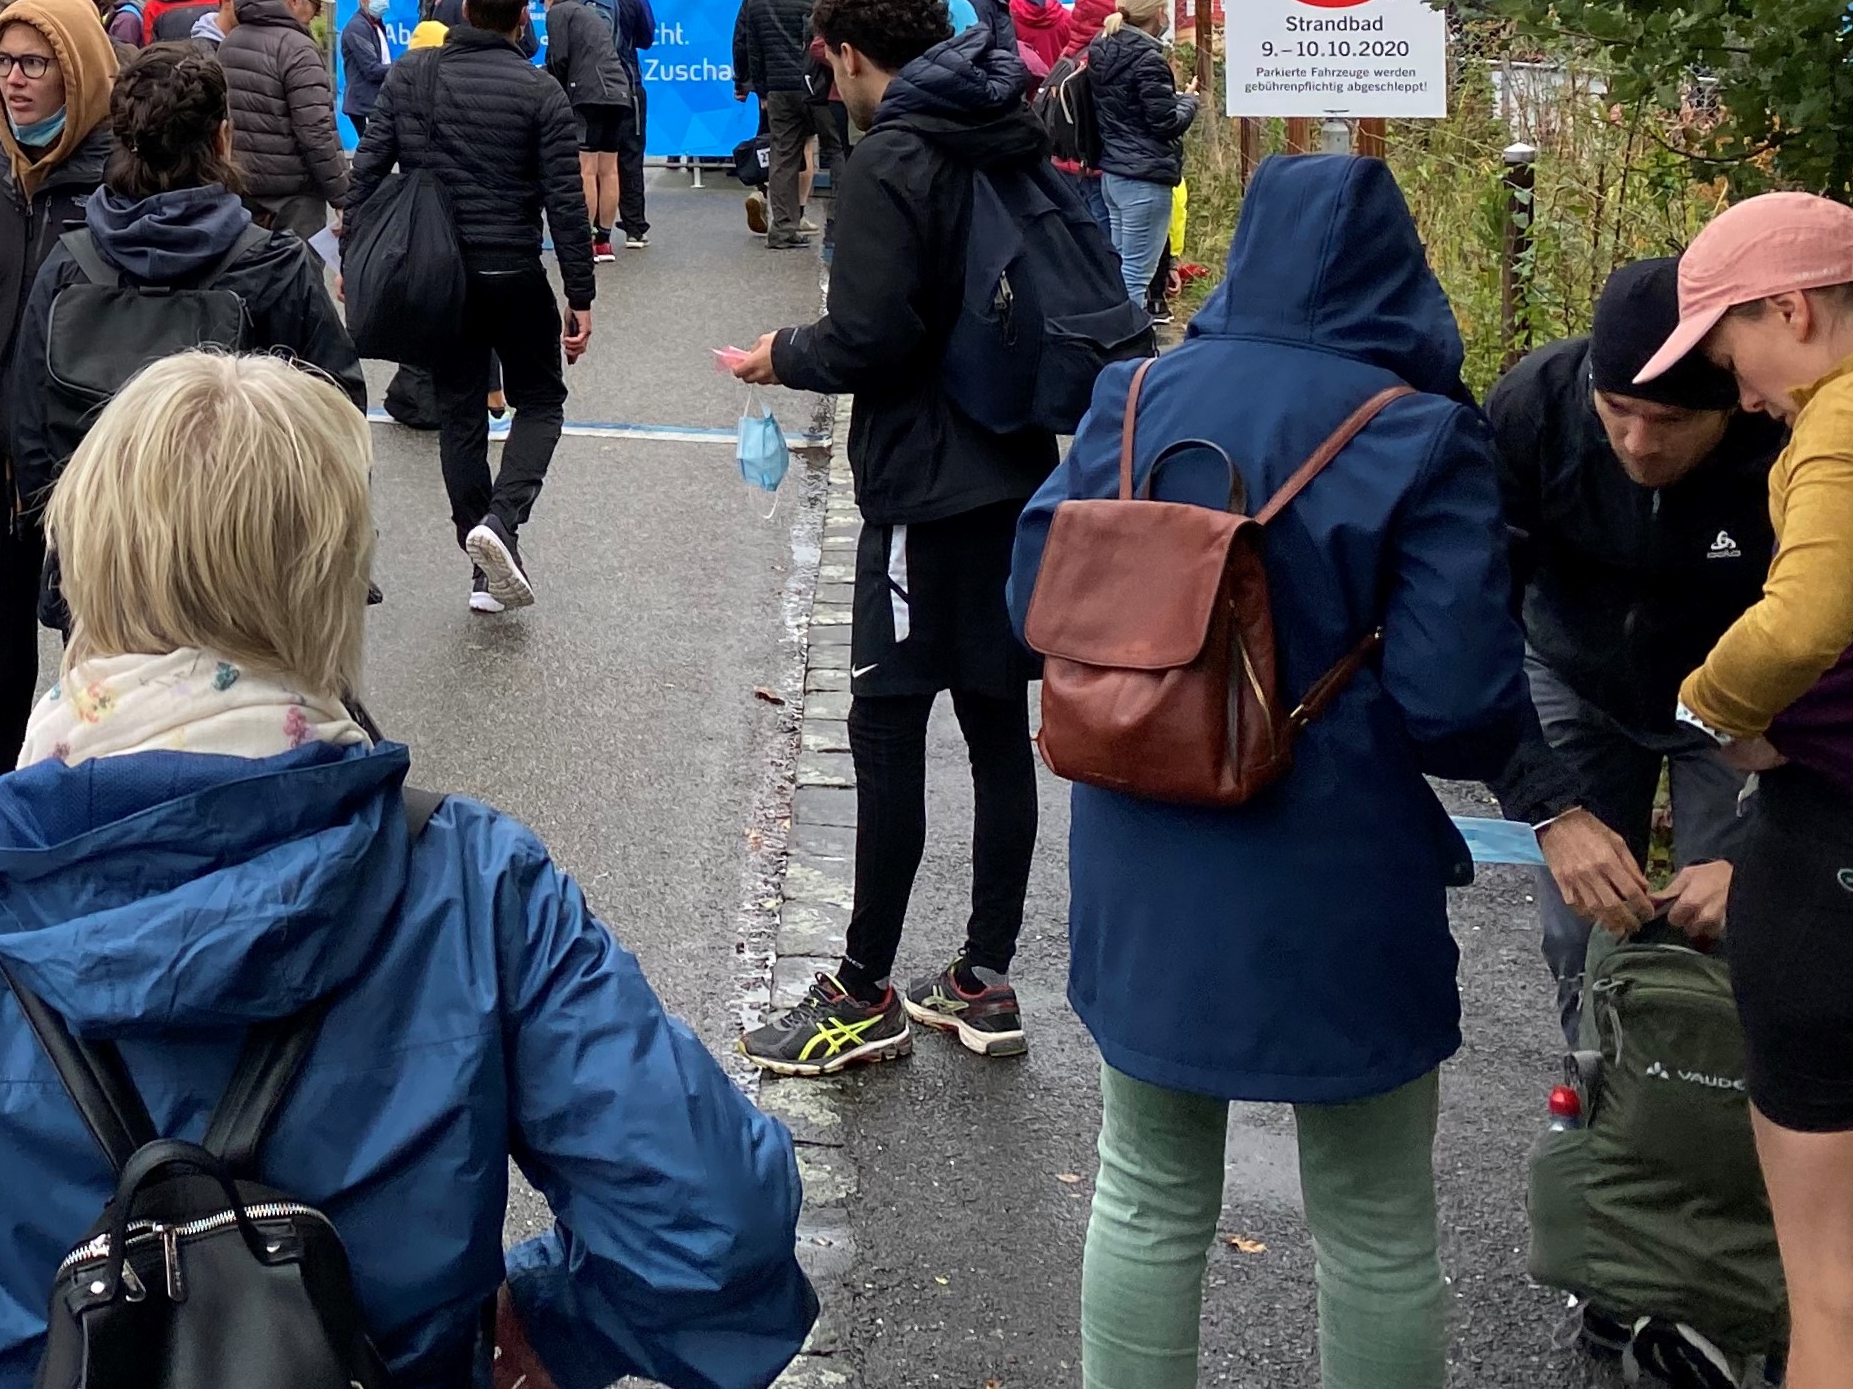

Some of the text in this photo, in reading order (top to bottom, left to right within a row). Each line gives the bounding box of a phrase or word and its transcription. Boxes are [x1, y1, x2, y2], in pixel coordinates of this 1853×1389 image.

[1286, 15, 1384, 32] Strandbad
[1256, 67, 1416, 79] Parkierte Fahrzeuge werden
[1244, 82, 1428, 93] gebührenpflichtig abgeschleppt!
